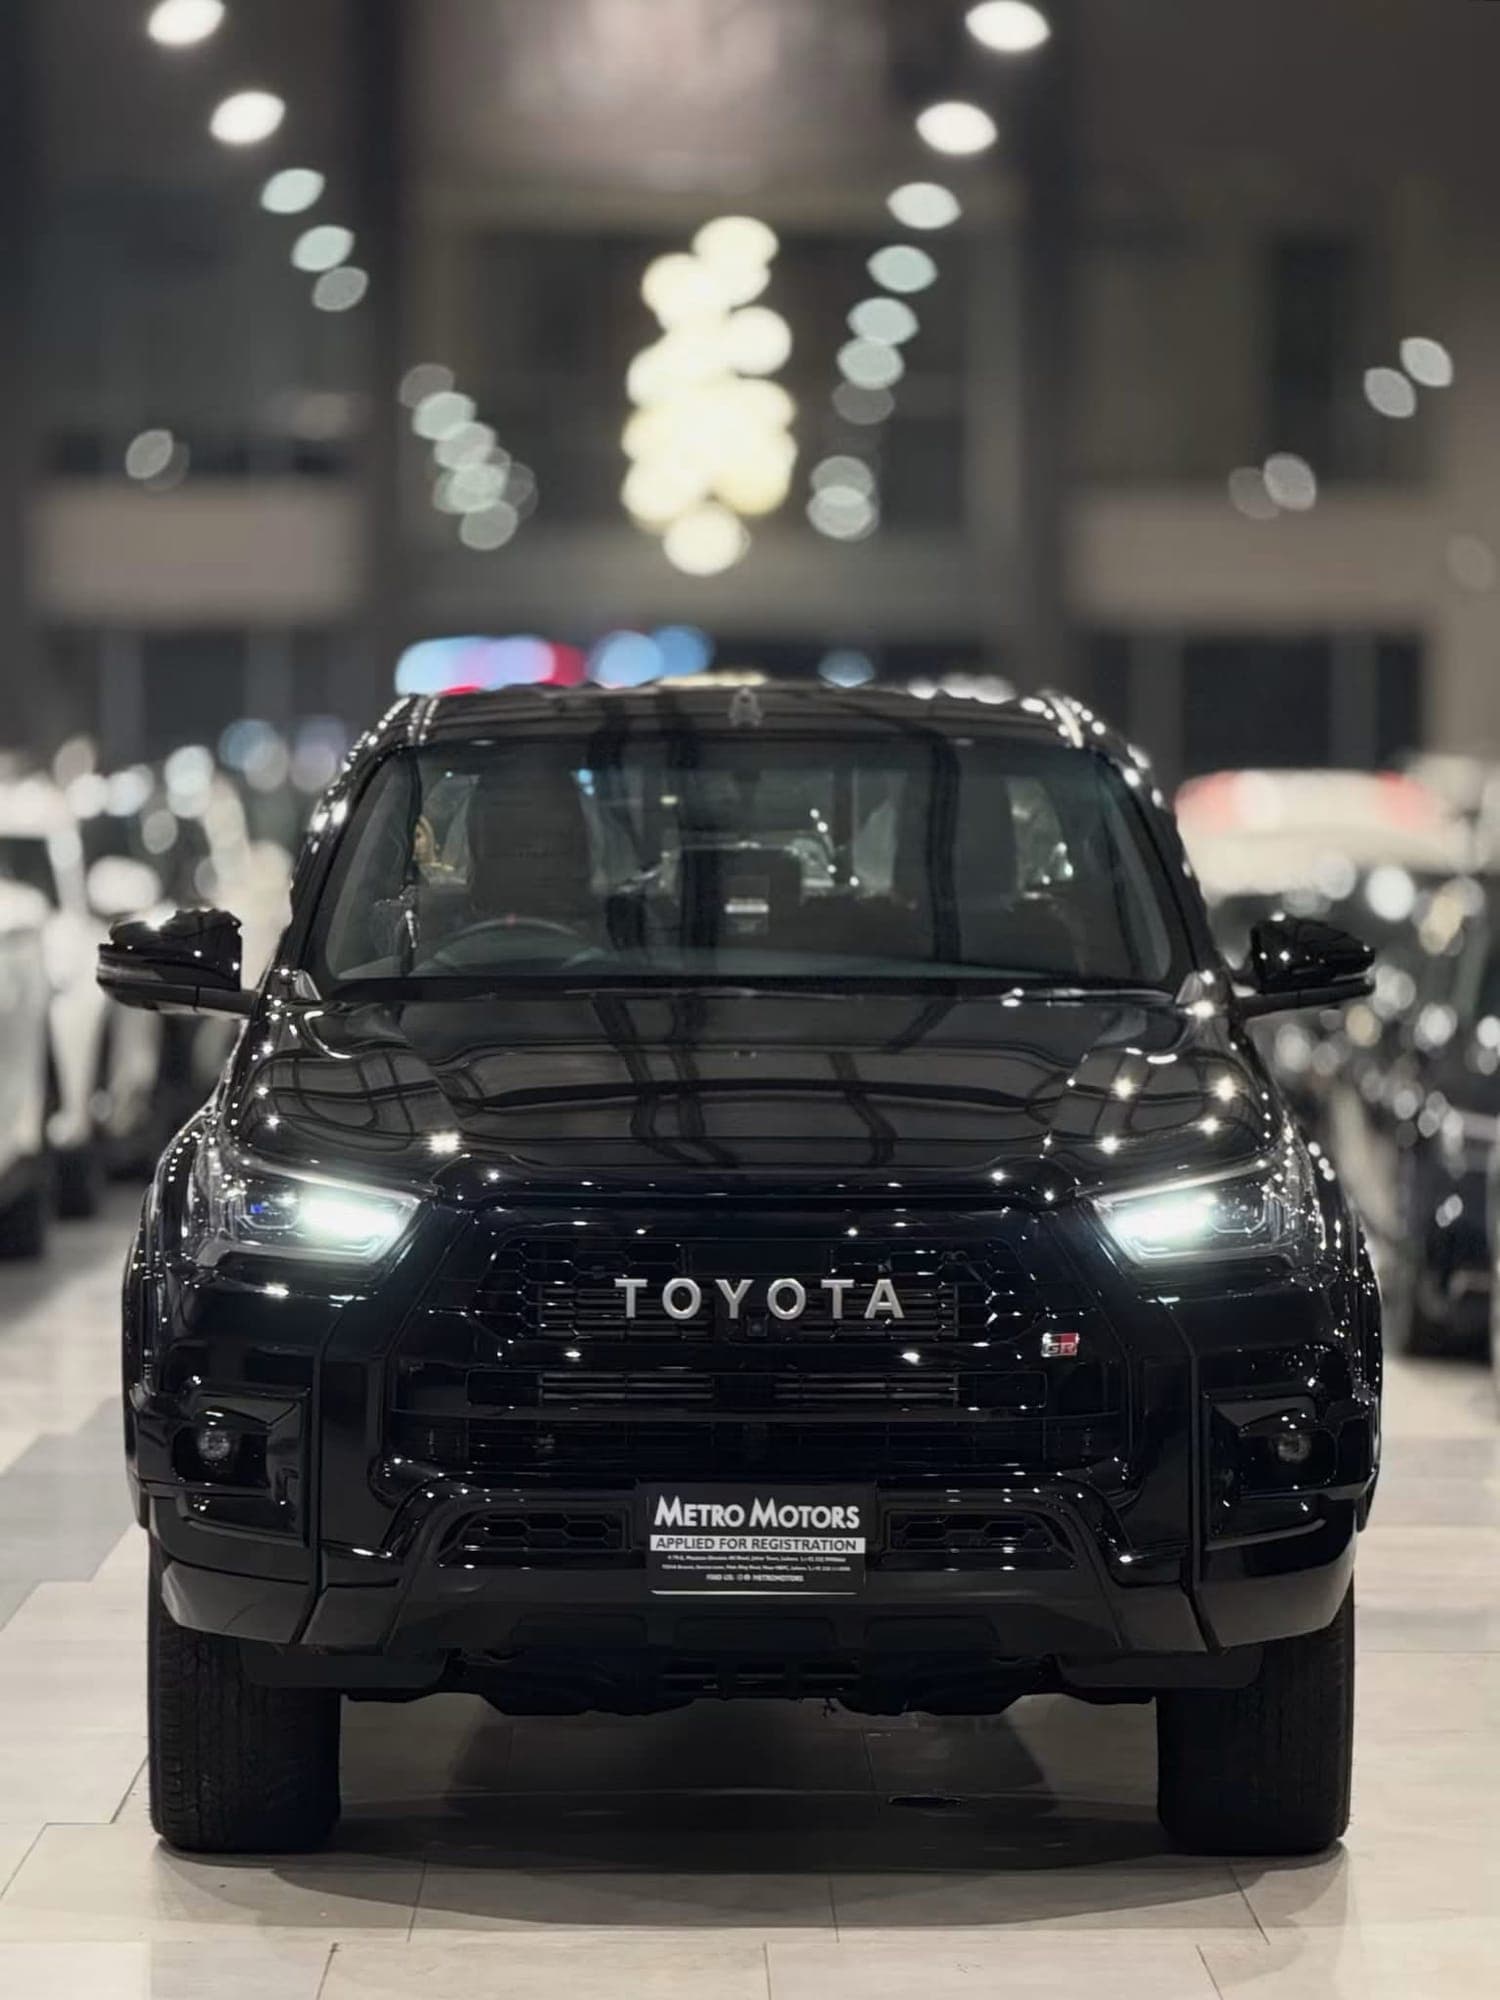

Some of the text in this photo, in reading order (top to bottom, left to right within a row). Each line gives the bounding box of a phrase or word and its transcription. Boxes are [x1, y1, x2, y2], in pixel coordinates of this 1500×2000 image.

[614, 1277, 905, 1320] TOYOTA
[654, 1495, 860, 1529] METRO MOTORS
[656, 1537, 857, 1551] APPLIED FOR REGISTRATION
